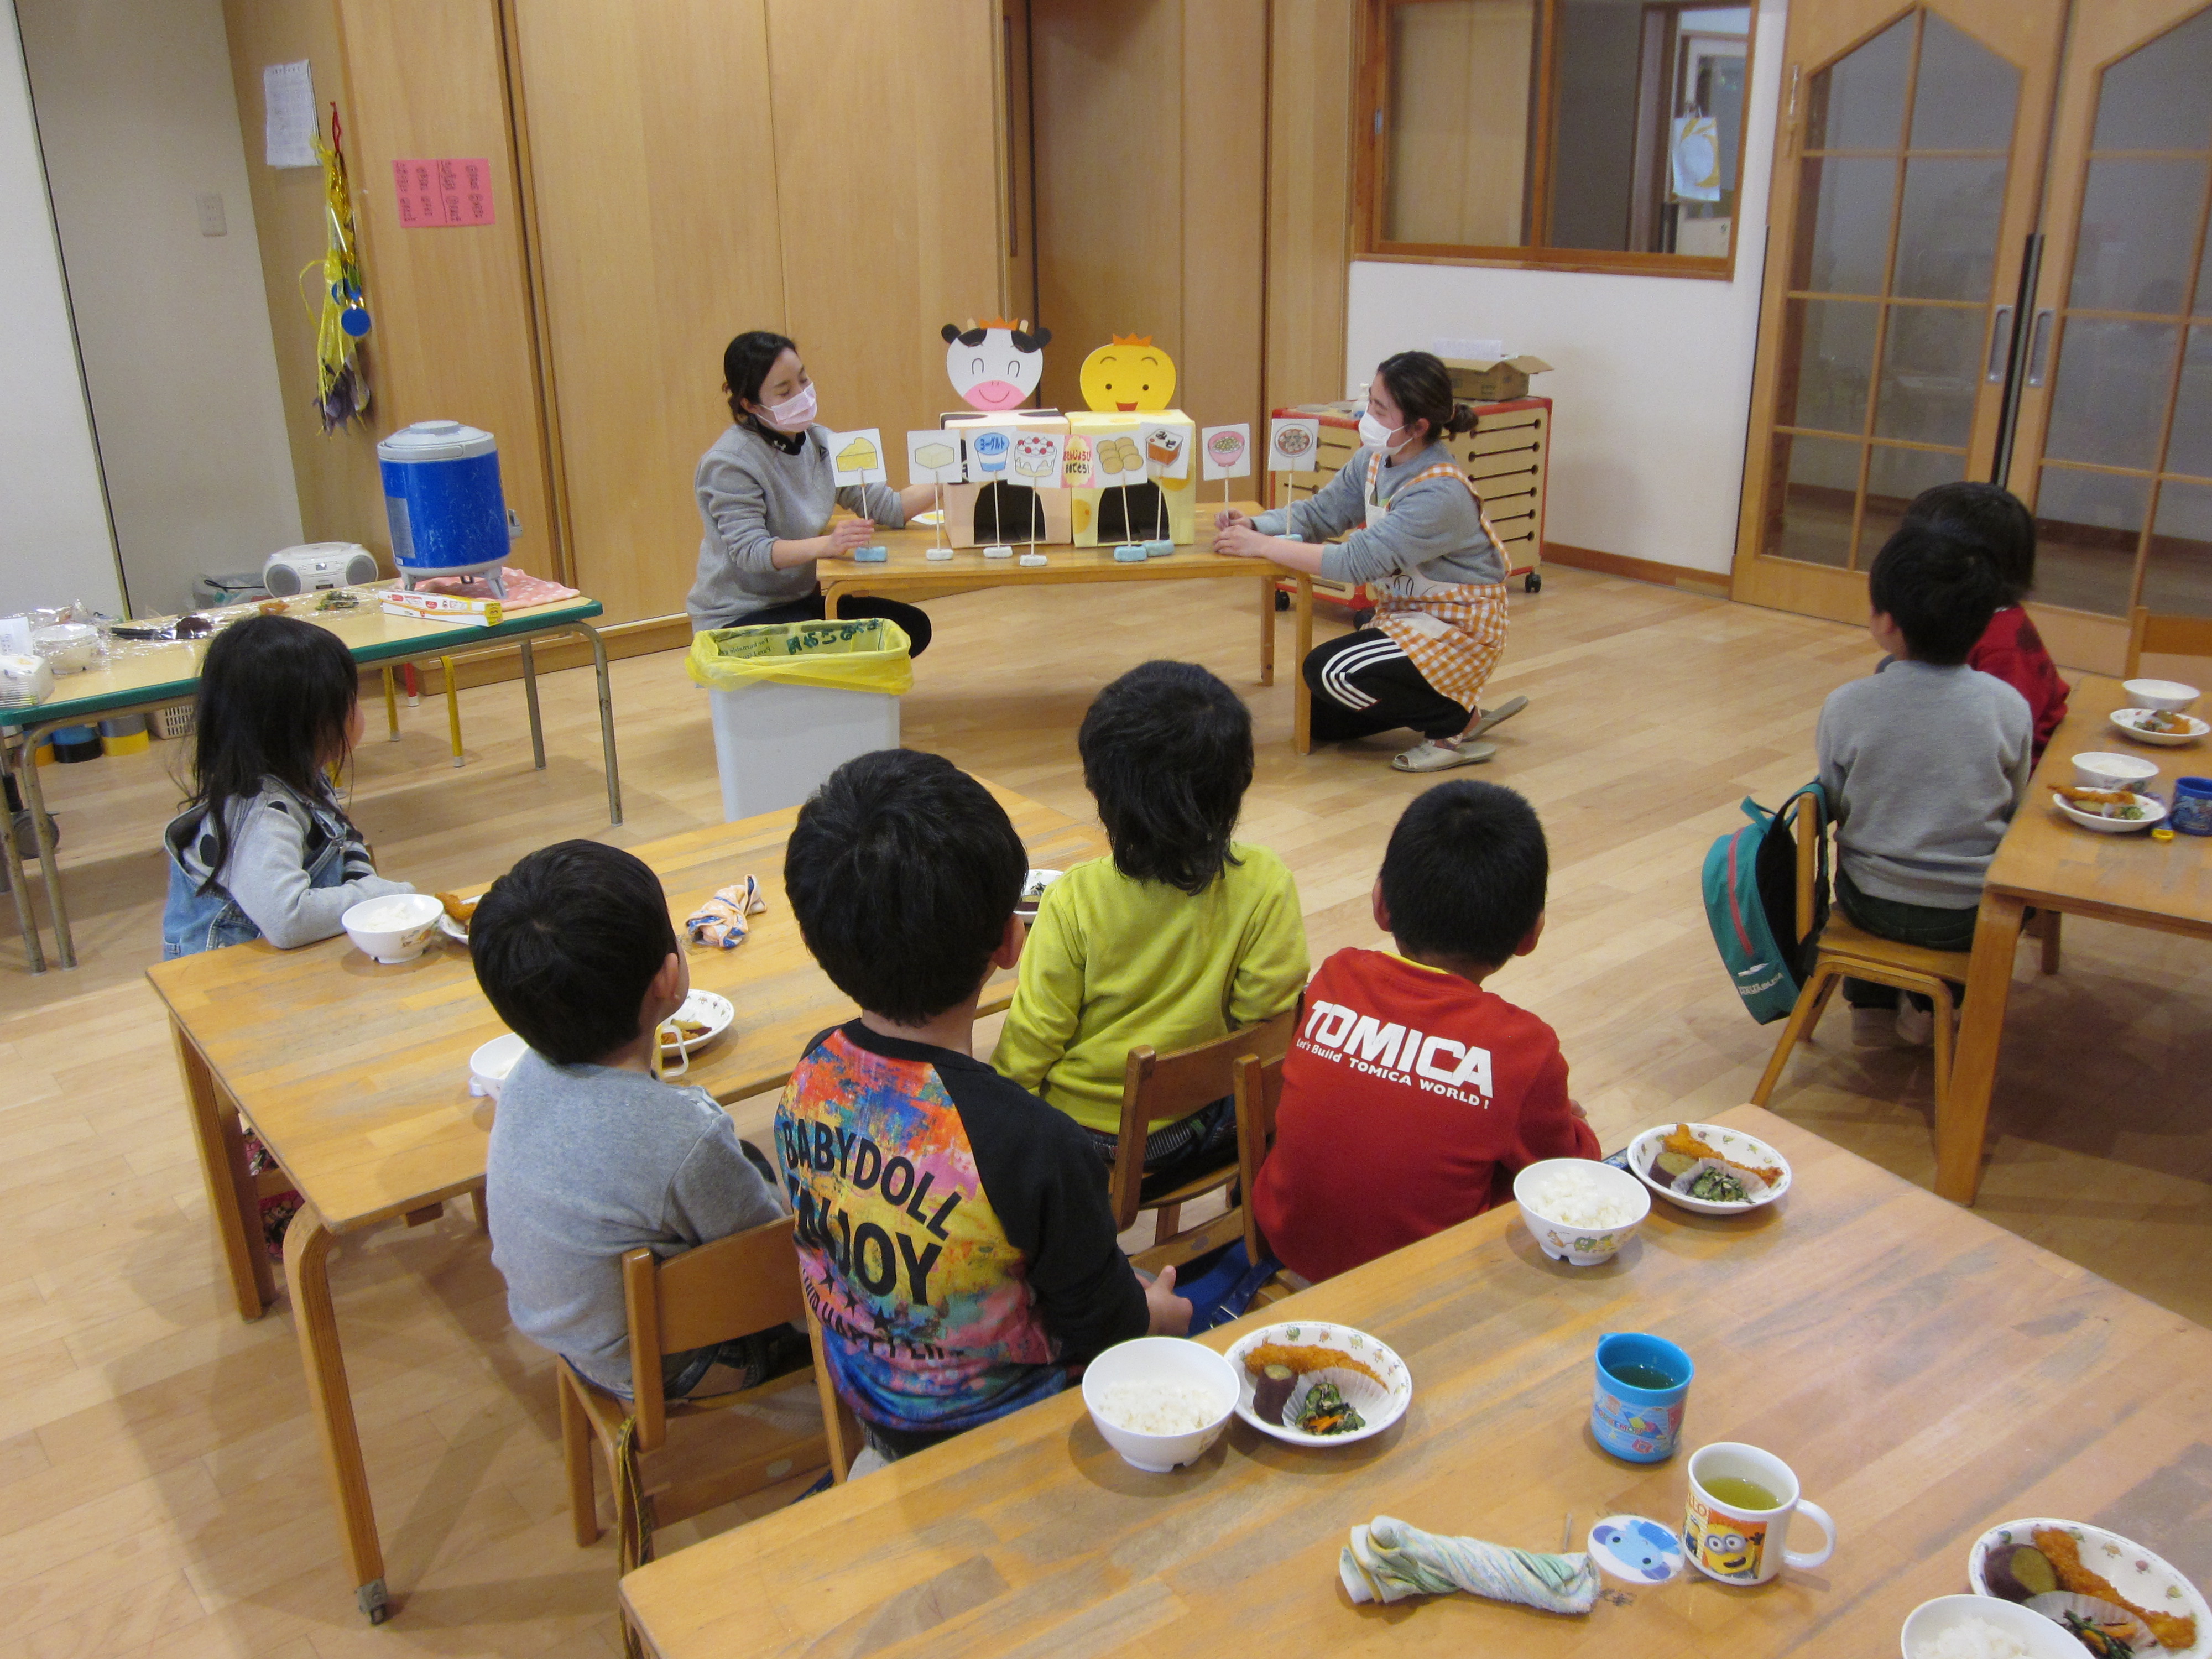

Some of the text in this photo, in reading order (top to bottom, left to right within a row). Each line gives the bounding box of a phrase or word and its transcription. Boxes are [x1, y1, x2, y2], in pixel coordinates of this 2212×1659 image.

[980, 436, 1005, 451] ヨーグルト
[1155, 431, 1177, 449] みそ
[1305, 1000, 1494, 1098] TOMICA
[1311, 1044, 1342, 1063] Build
[1349, 1057, 1412, 1086] TOMICA
[782, 1118, 963, 1241] BABYDOLL
